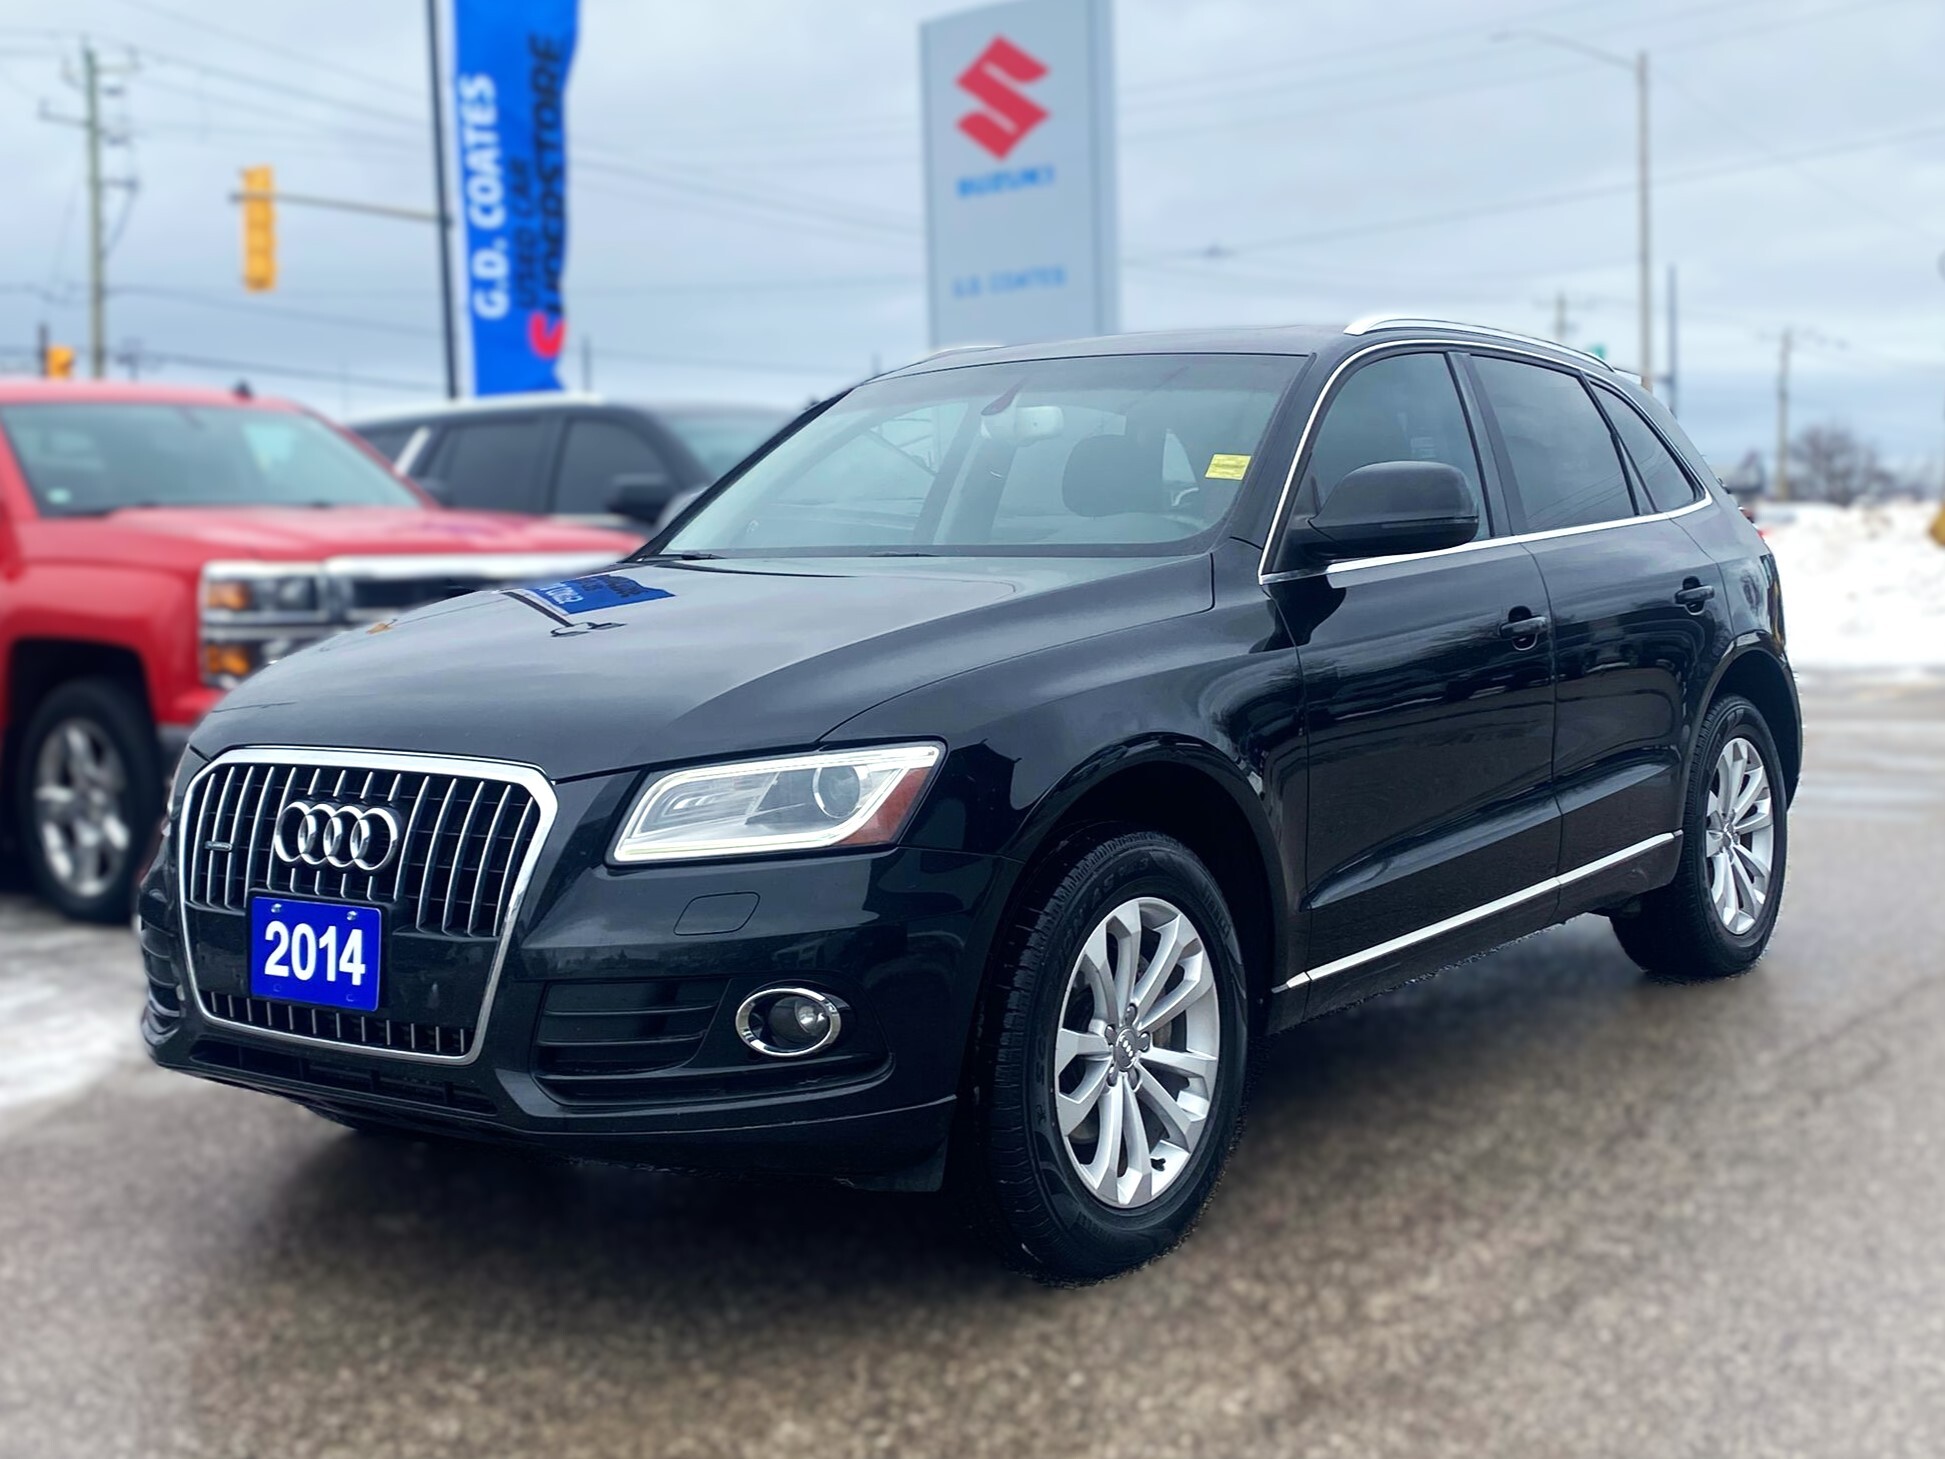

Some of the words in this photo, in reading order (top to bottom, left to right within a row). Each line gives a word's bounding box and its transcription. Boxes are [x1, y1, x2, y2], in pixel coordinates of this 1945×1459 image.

[459, 74, 506, 229] COATES
[472, 238, 509, 319] G.D.
[264, 920, 366, 986] 2014
